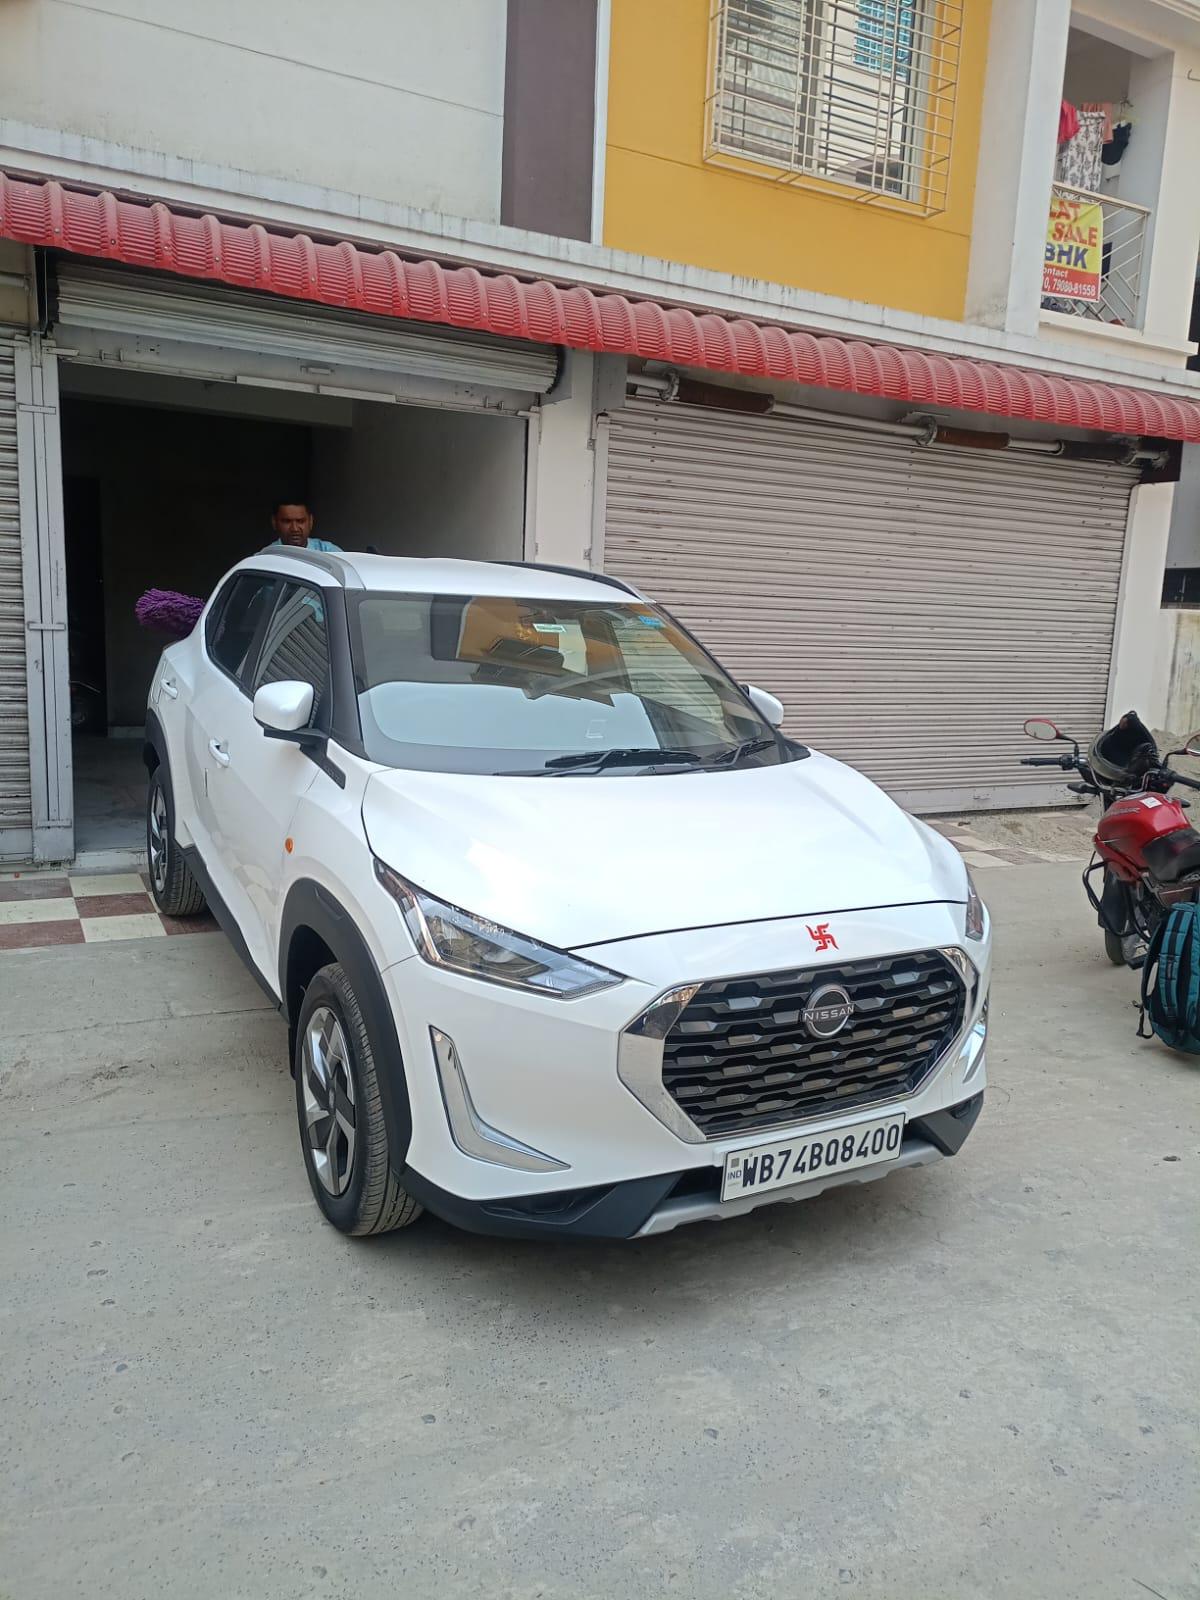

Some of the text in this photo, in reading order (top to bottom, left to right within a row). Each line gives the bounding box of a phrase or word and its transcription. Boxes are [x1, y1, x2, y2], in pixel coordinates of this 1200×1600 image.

[1052, 222, 1098, 248] SALE
[1045, 242, 1089, 269] BHK
[804, 1004, 854, 1020] NISSAN
[742, 1123, 900, 1188] WB74BQ8400
[727, 1169, 742, 1181] IND
